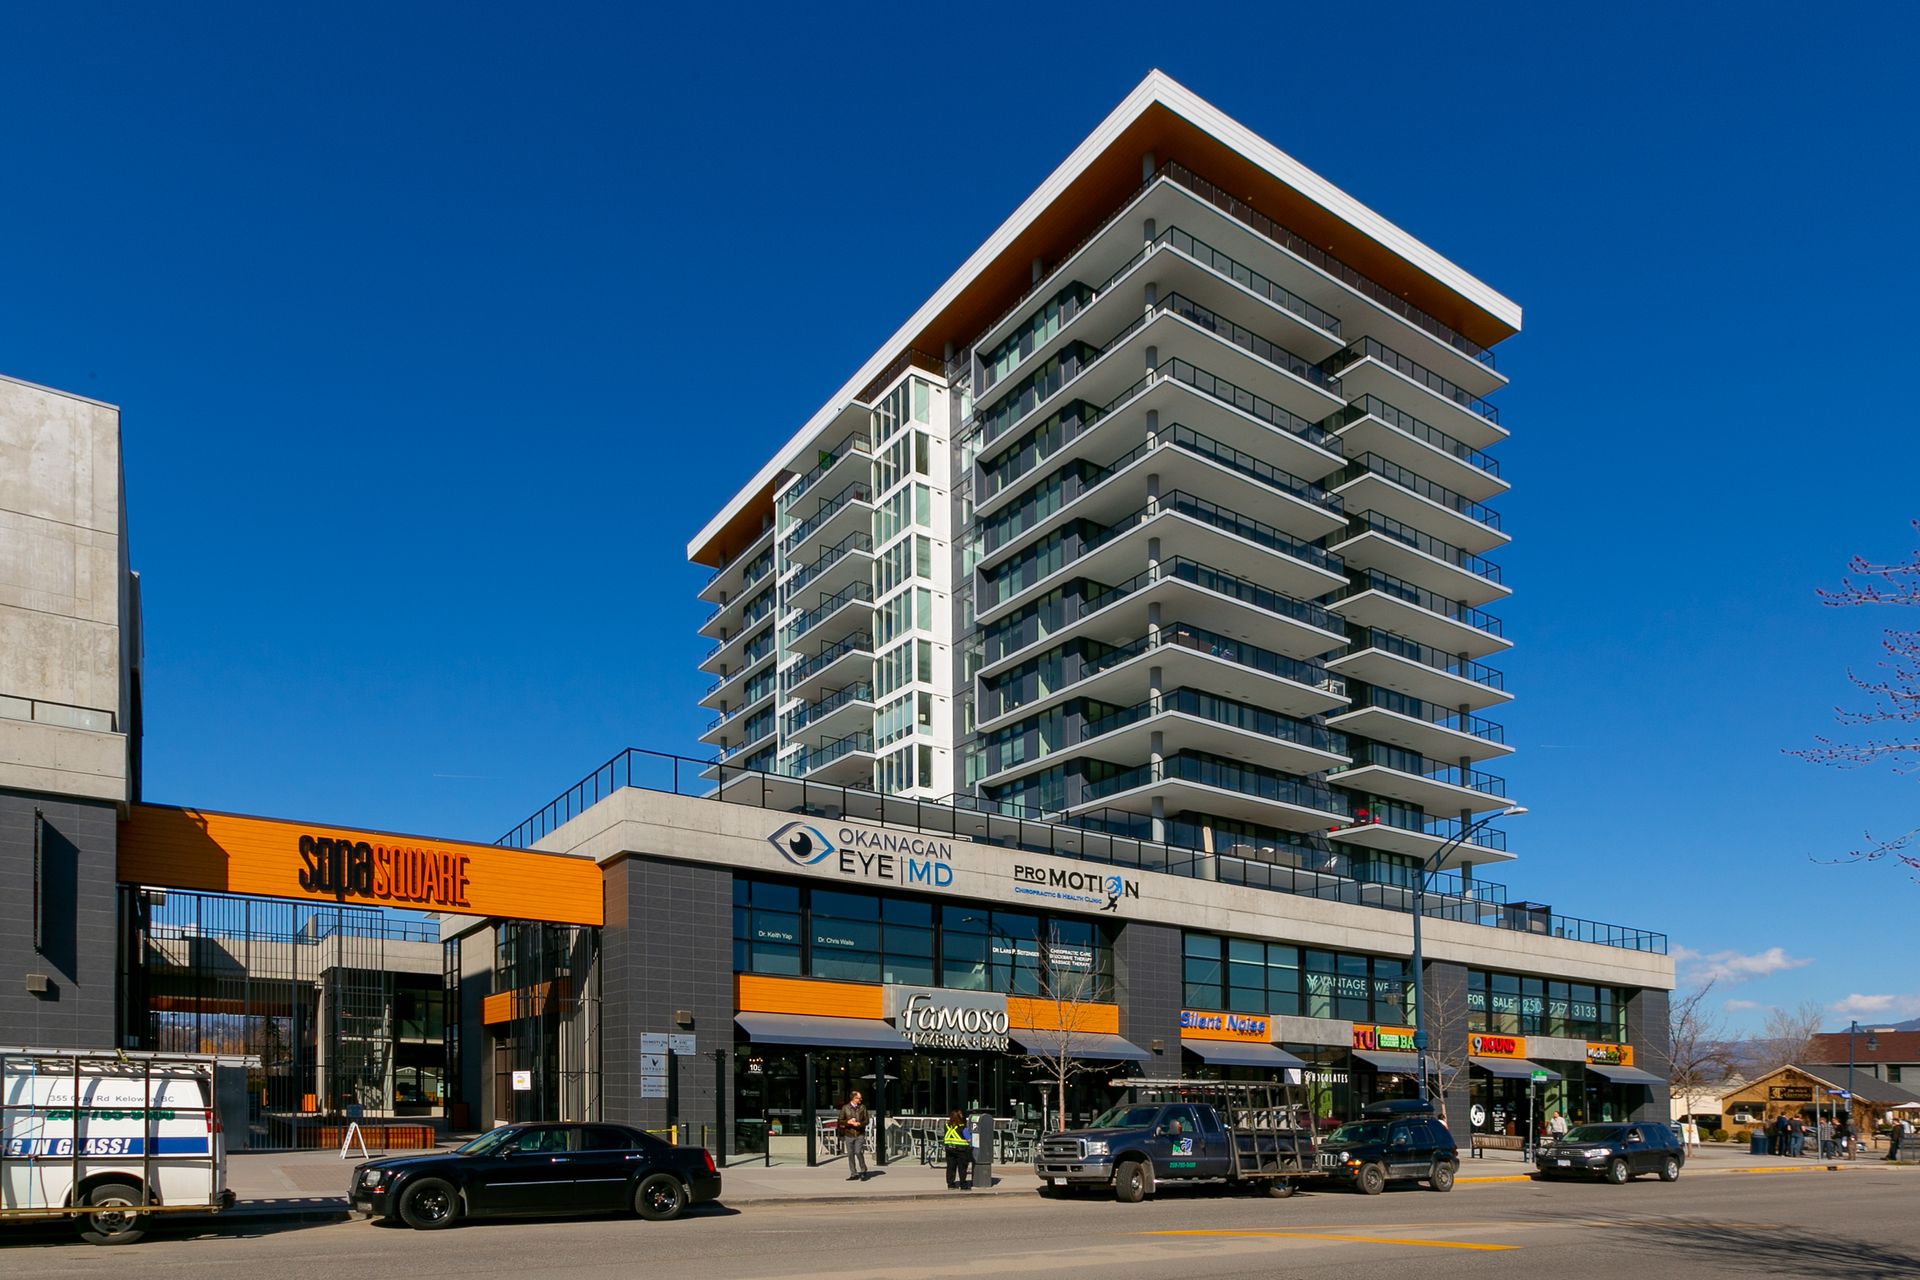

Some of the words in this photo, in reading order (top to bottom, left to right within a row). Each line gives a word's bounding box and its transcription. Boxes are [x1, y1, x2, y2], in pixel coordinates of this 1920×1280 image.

[839, 828, 952, 860] OKANAGAN
[372, 844, 471, 908] SQUARE
[839, 849, 894, 880] EYE
[908, 858, 954, 888] MD
[1014, 865, 1046, 882] PRO
[1467, 994, 1484, 1005] FOR
[1493, 997, 1514, 1008] SALE
[1180, 1011, 1221, 1030] Silent
[1227, 1015, 1265, 1033] Noise
[981, 1036, 1009, 1052] BAR
